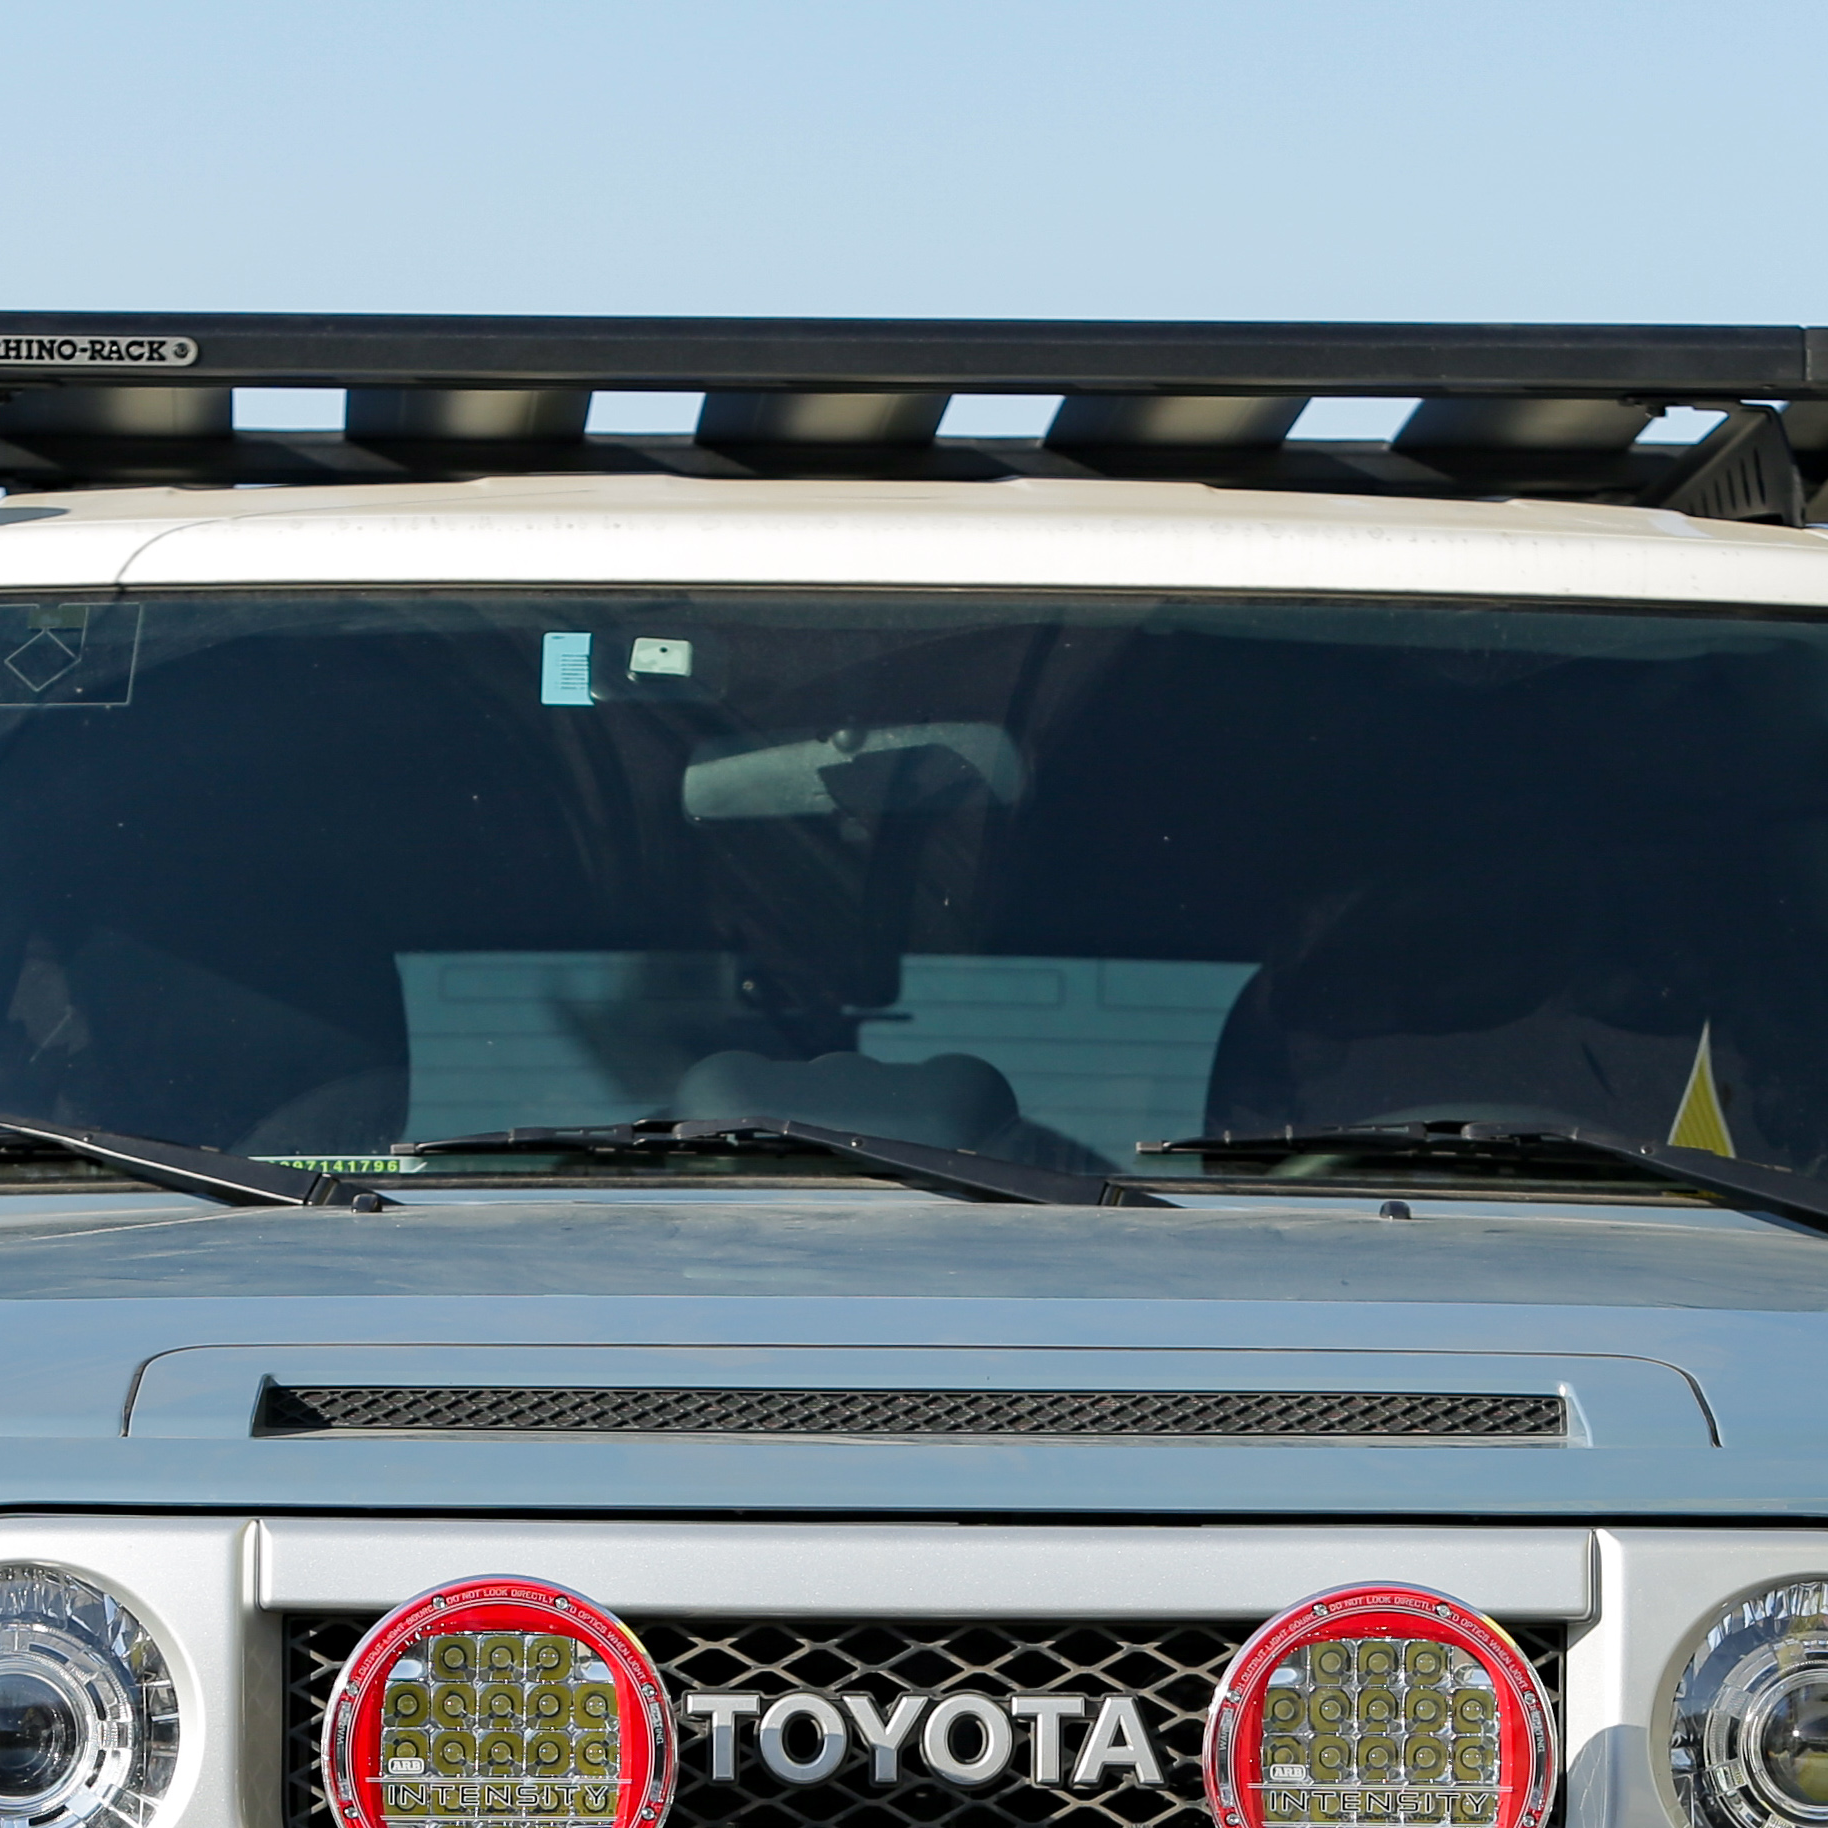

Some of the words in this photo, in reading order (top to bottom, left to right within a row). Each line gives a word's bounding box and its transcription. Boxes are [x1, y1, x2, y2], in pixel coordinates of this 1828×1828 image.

[269, 1160, 398, 1173] 97141796
[403, 1601, 437, 1626] SOURC
[444, 1593, 461, 1605] DO
[460, 1589, 480, 1601] NOT
[482, 1587, 508, 1597] LOOK
[509, 1588, 555, 1605] DIRECTLY
[576, 1608, 608, 1634] OPTICS
[604, 1630, 630, 1657] WHEN
[625, 1654, 646, 1681] LIGHT
[1263, 1627, 1288, 1651] LIGHT
[1286, 1608, 1319, 1632] SOURC
[1327, 1600, 1343, 1612] DO
[1343, 1596, 1362, 1607] NOT
[1365, 1594, 1391, 1604] LOOK
[1458, 1616, 1490, 1643] OPTICS
[1486, 1638, 1513, 1666] WHEN
[1507, 1662, 1528, 1690] LIGHT
[686, 1693, 1166, 1785] TOYOTA
[391, 1760, 422, 1771] ARB
[1273, 1766, 1304, 1778] ARB
[389, 1784, 609, 1807] INTENSITY
[1270, 1790, 1490, 1814] INTENSITY
